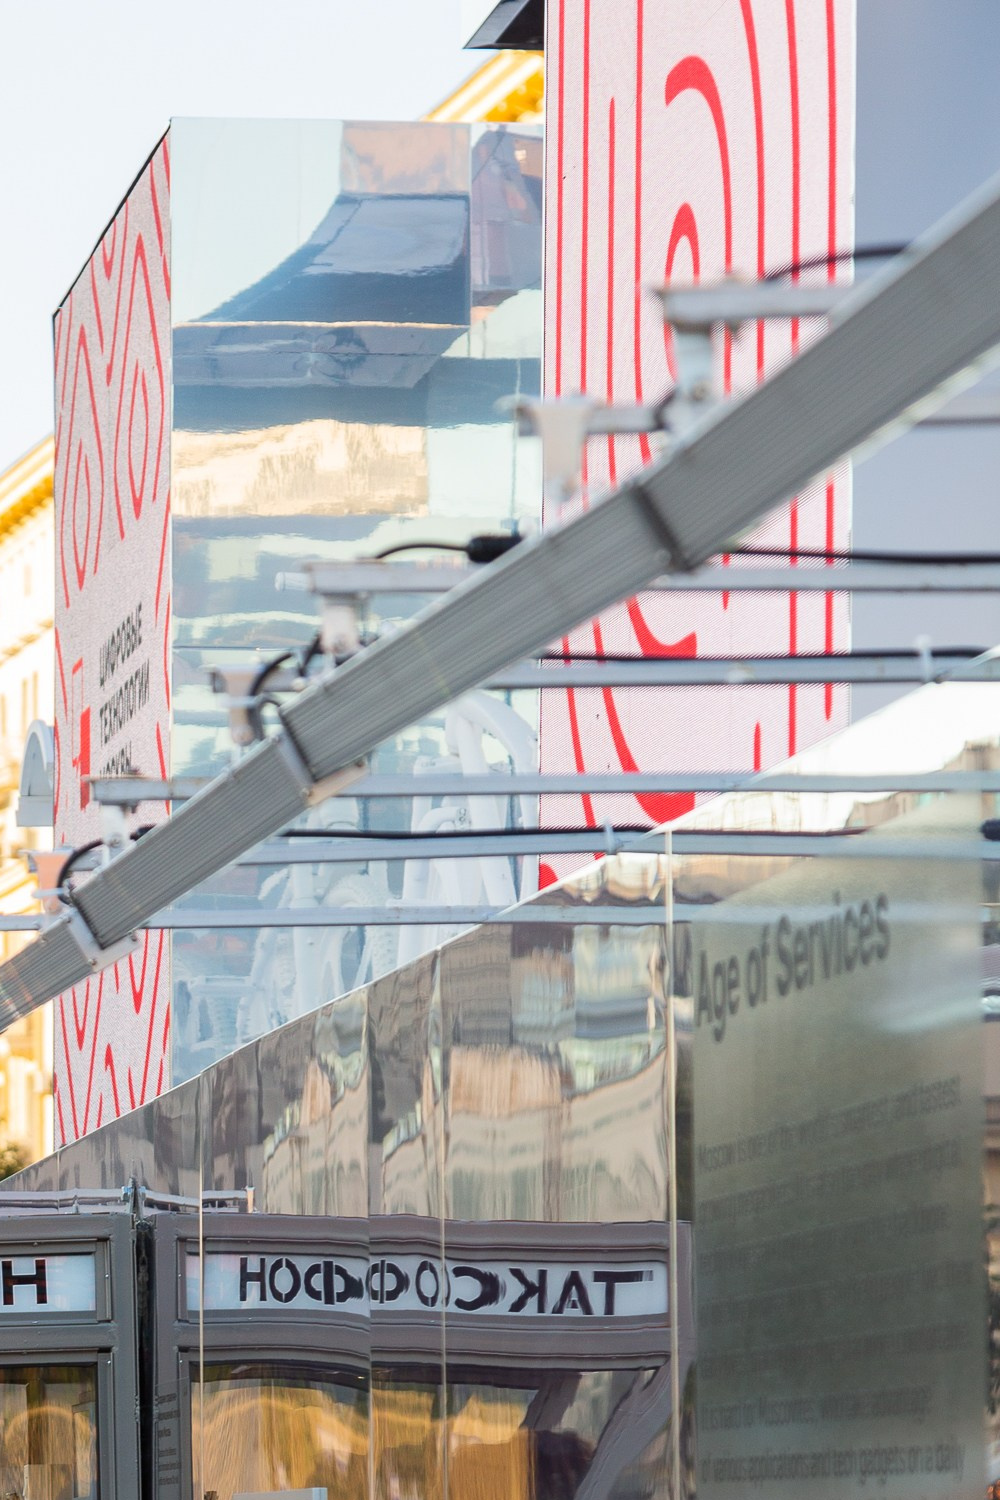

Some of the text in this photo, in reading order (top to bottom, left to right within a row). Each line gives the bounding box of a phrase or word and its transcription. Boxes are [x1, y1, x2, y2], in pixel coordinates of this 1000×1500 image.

[99, 658, 150, 746] ТЕХНОЛОГИИ
[696, 890, 890, 1043] Age of Services
